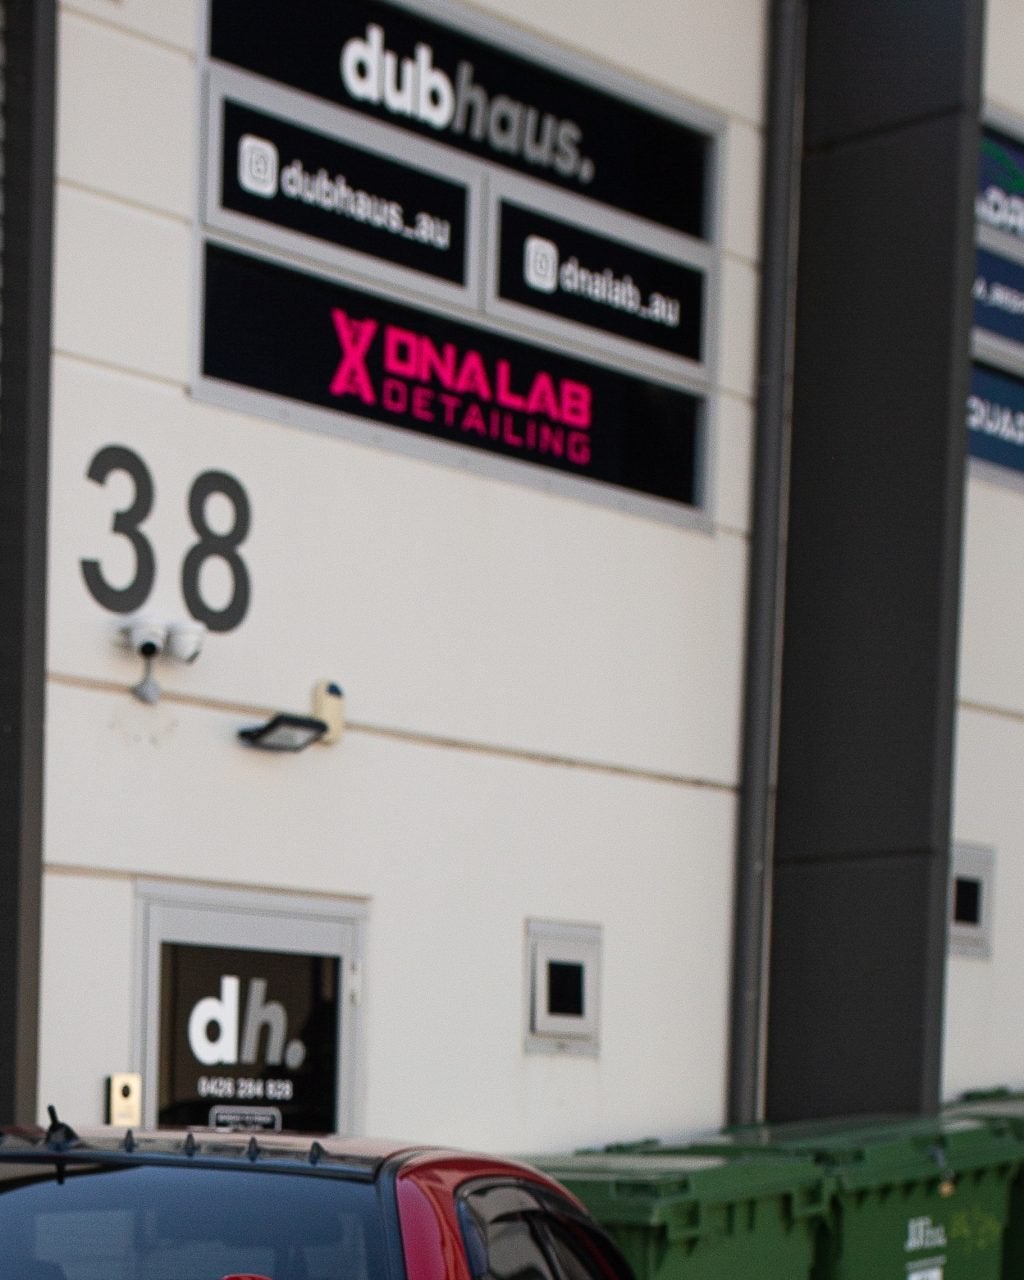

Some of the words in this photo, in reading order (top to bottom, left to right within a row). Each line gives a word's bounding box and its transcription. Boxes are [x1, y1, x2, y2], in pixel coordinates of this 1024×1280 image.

[340, 22, 595, 184] dubhaus.
[281, 160, 450, 249] dubhaus_au
[560, 256, 680, 327] dnalab_au
[382, 378, 591, 465] DETAILING
[80, 444, 251, 633] 38
[188, 975, 306, 1069] dh.
